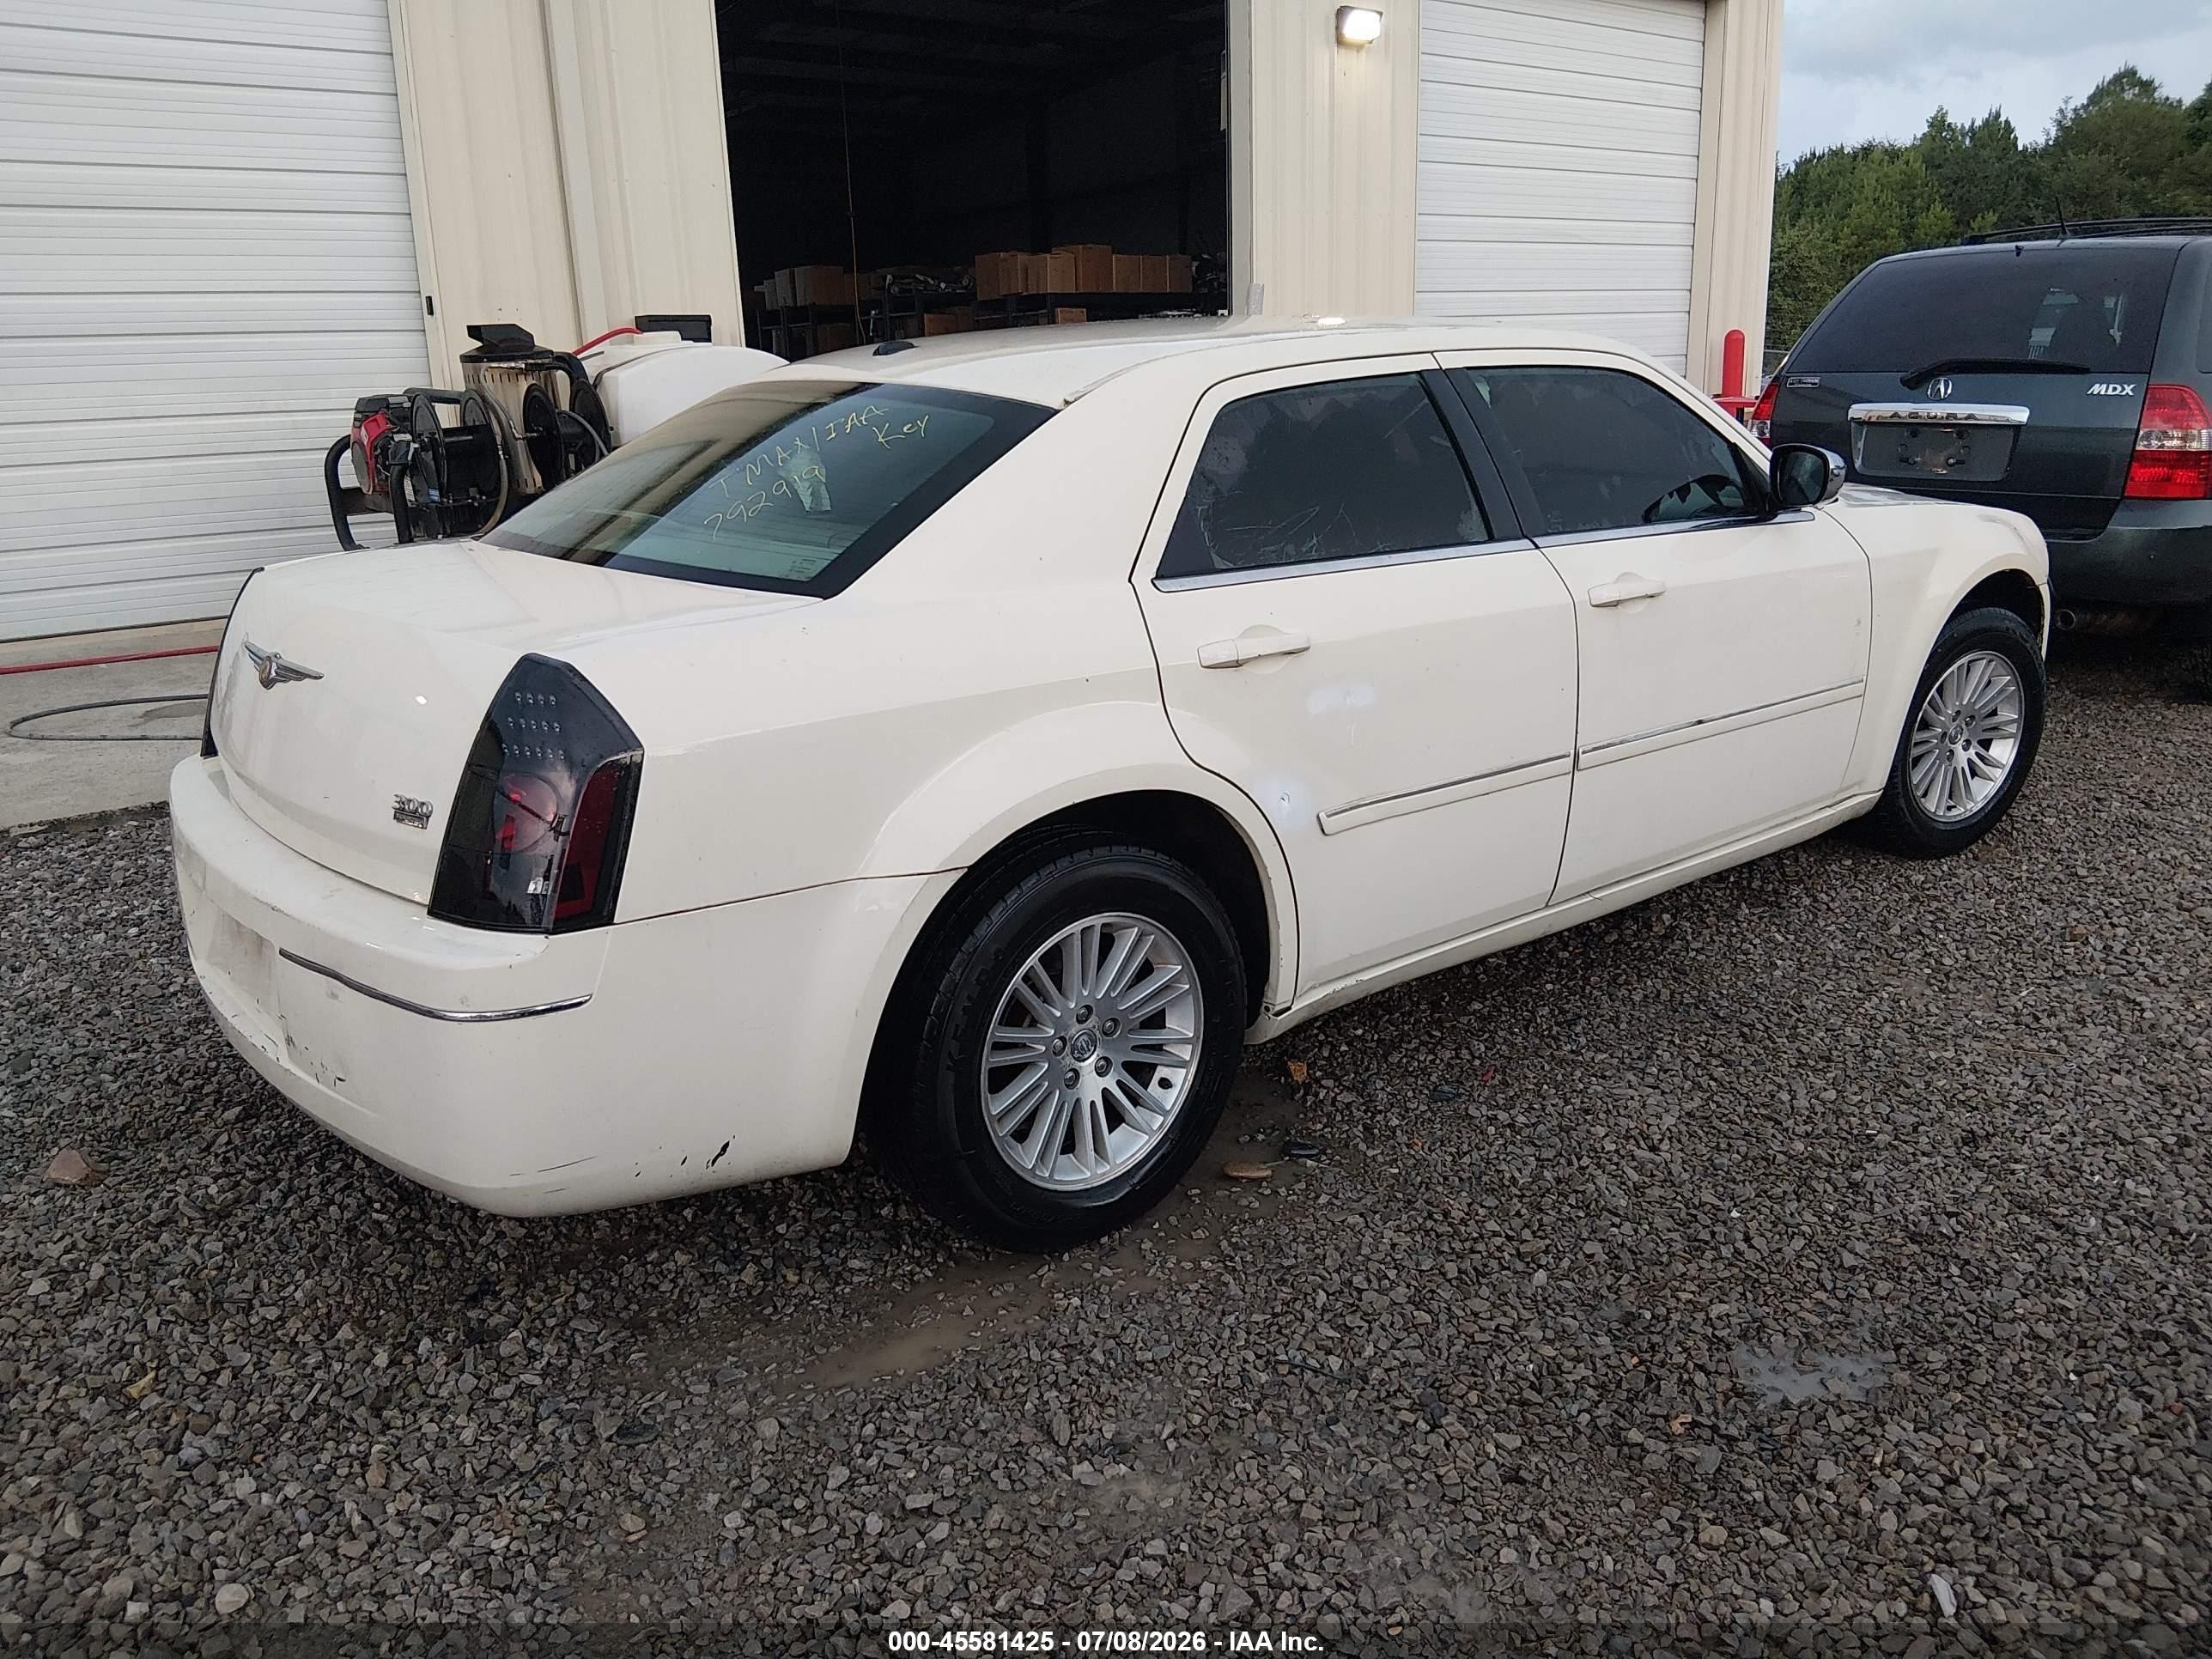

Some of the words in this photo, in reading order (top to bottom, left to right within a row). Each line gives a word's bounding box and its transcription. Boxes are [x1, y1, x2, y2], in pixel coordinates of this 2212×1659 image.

[2085, 382, 2136, 397] MDX
[1888, 411, 1979, 422] ACURA
[704, 465, 826, 539] 792919
[392, 793, 434, 818] 300
